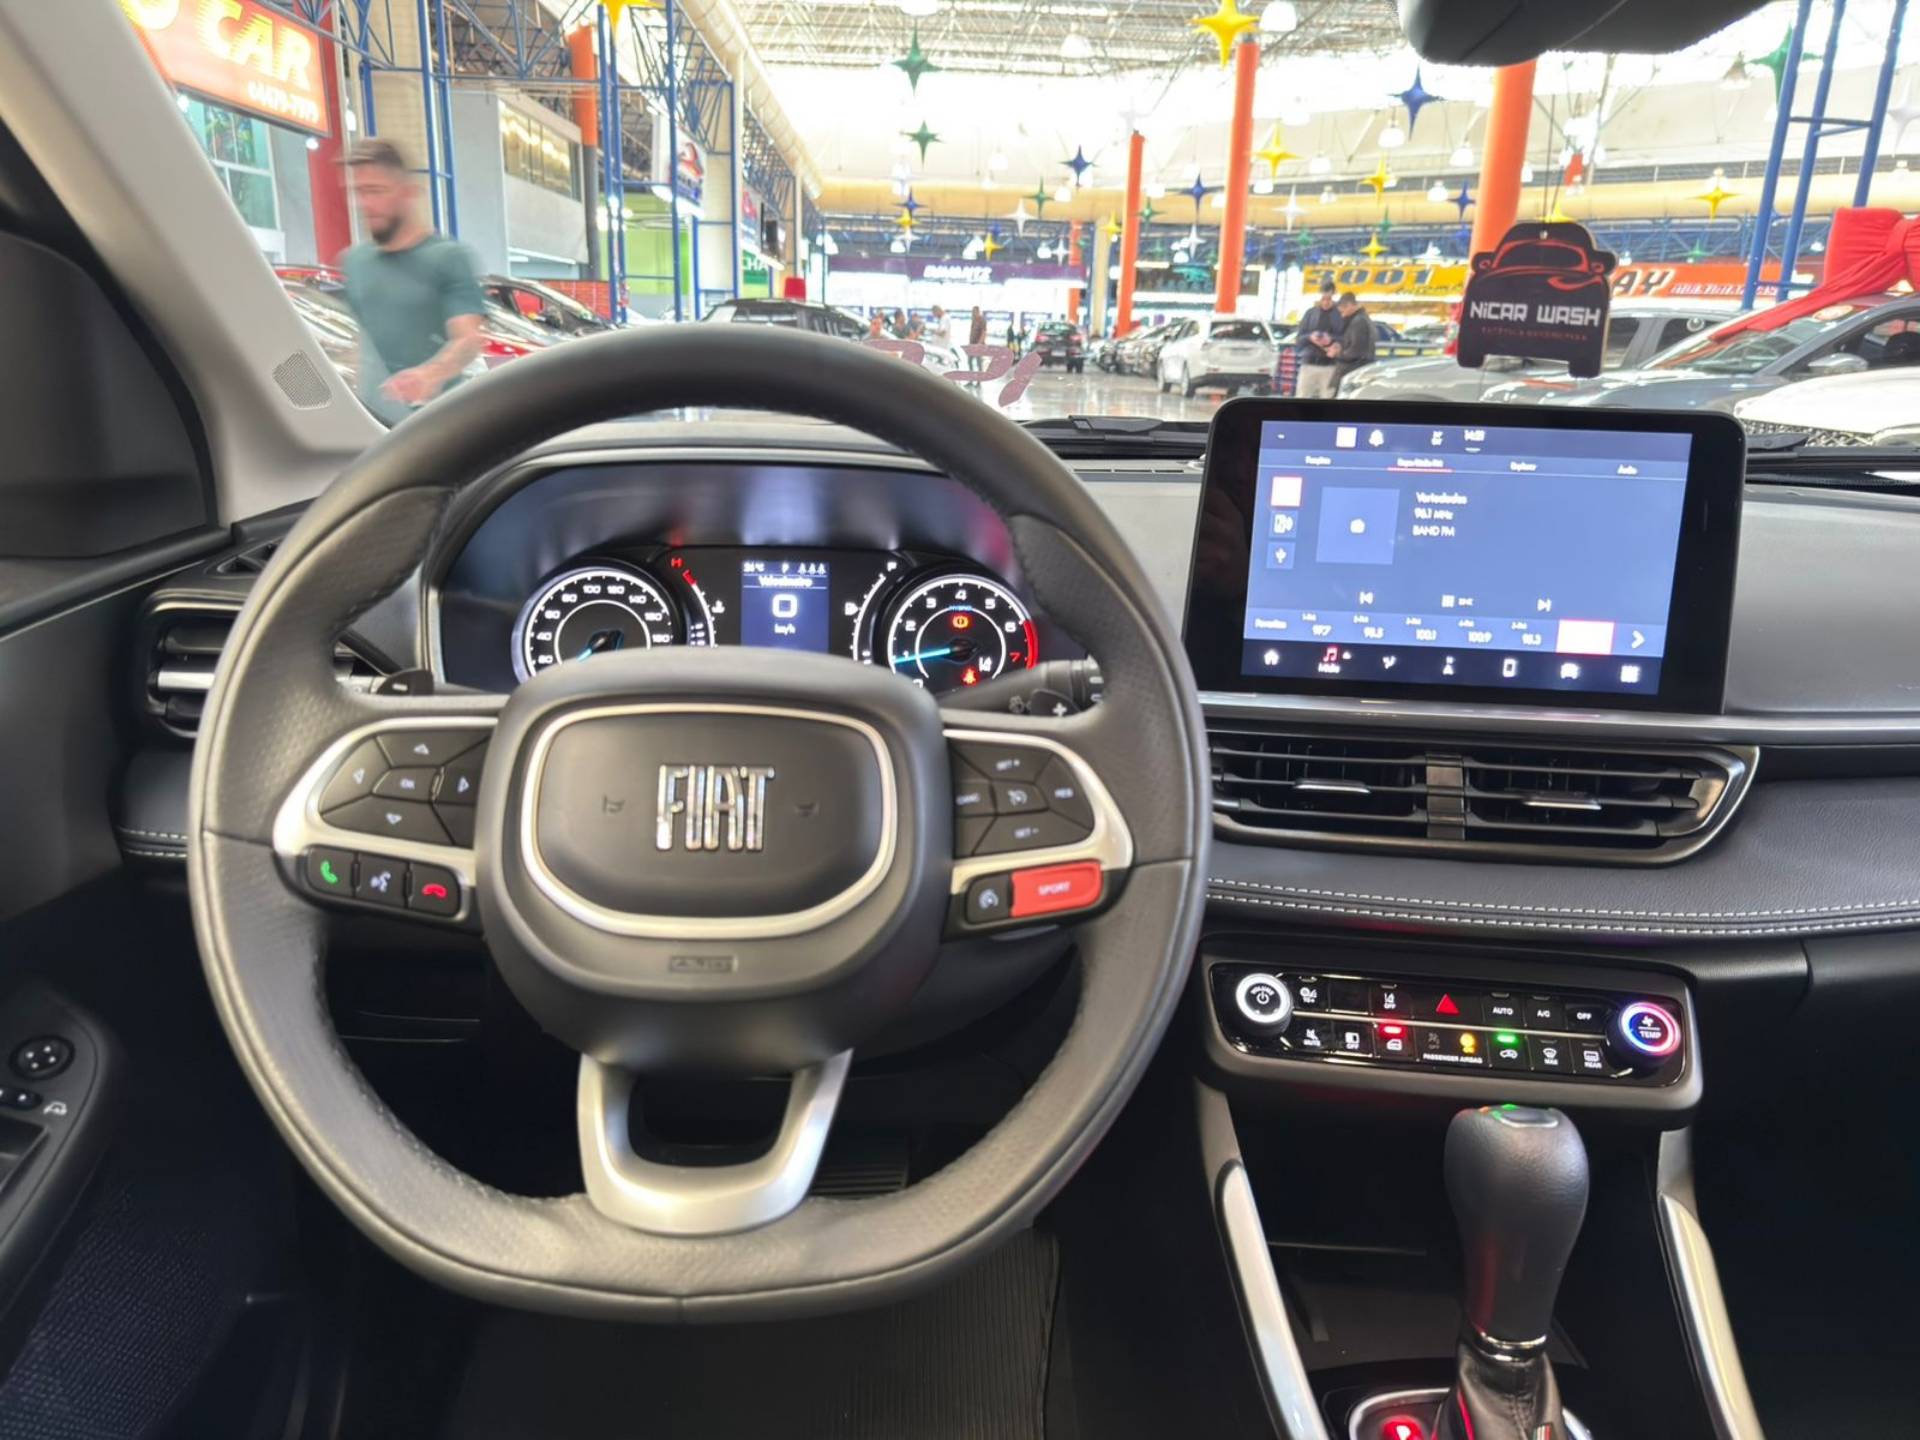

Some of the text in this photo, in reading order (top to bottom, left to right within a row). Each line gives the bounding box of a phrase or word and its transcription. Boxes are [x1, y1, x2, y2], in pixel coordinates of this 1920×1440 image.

[198, 0, 313, 92] CAR
[1536, 304, 1601, 326] WASH
[583, 584, 602, 595] 100
[954, 589, 967, 601] 4
[772, 593, 798, 619] 0
[904, 619, 917, 632] 2
[1004, 621, 1017, 633] 6
[536, 630, 553, 641] 40
[1009, 652, 1021, 663] 7
[656, 764, 776, 850] FIAT
[1038, 882, 1070, 897] SPORT
[1492, 1006, 1514, 1015] AUTO
[1576, 1012, 1592, 1021] OFF
[1639, 1030, 1662, 1039] TEMP
[1422, 1052, 1459, 1062] PASSENGER
